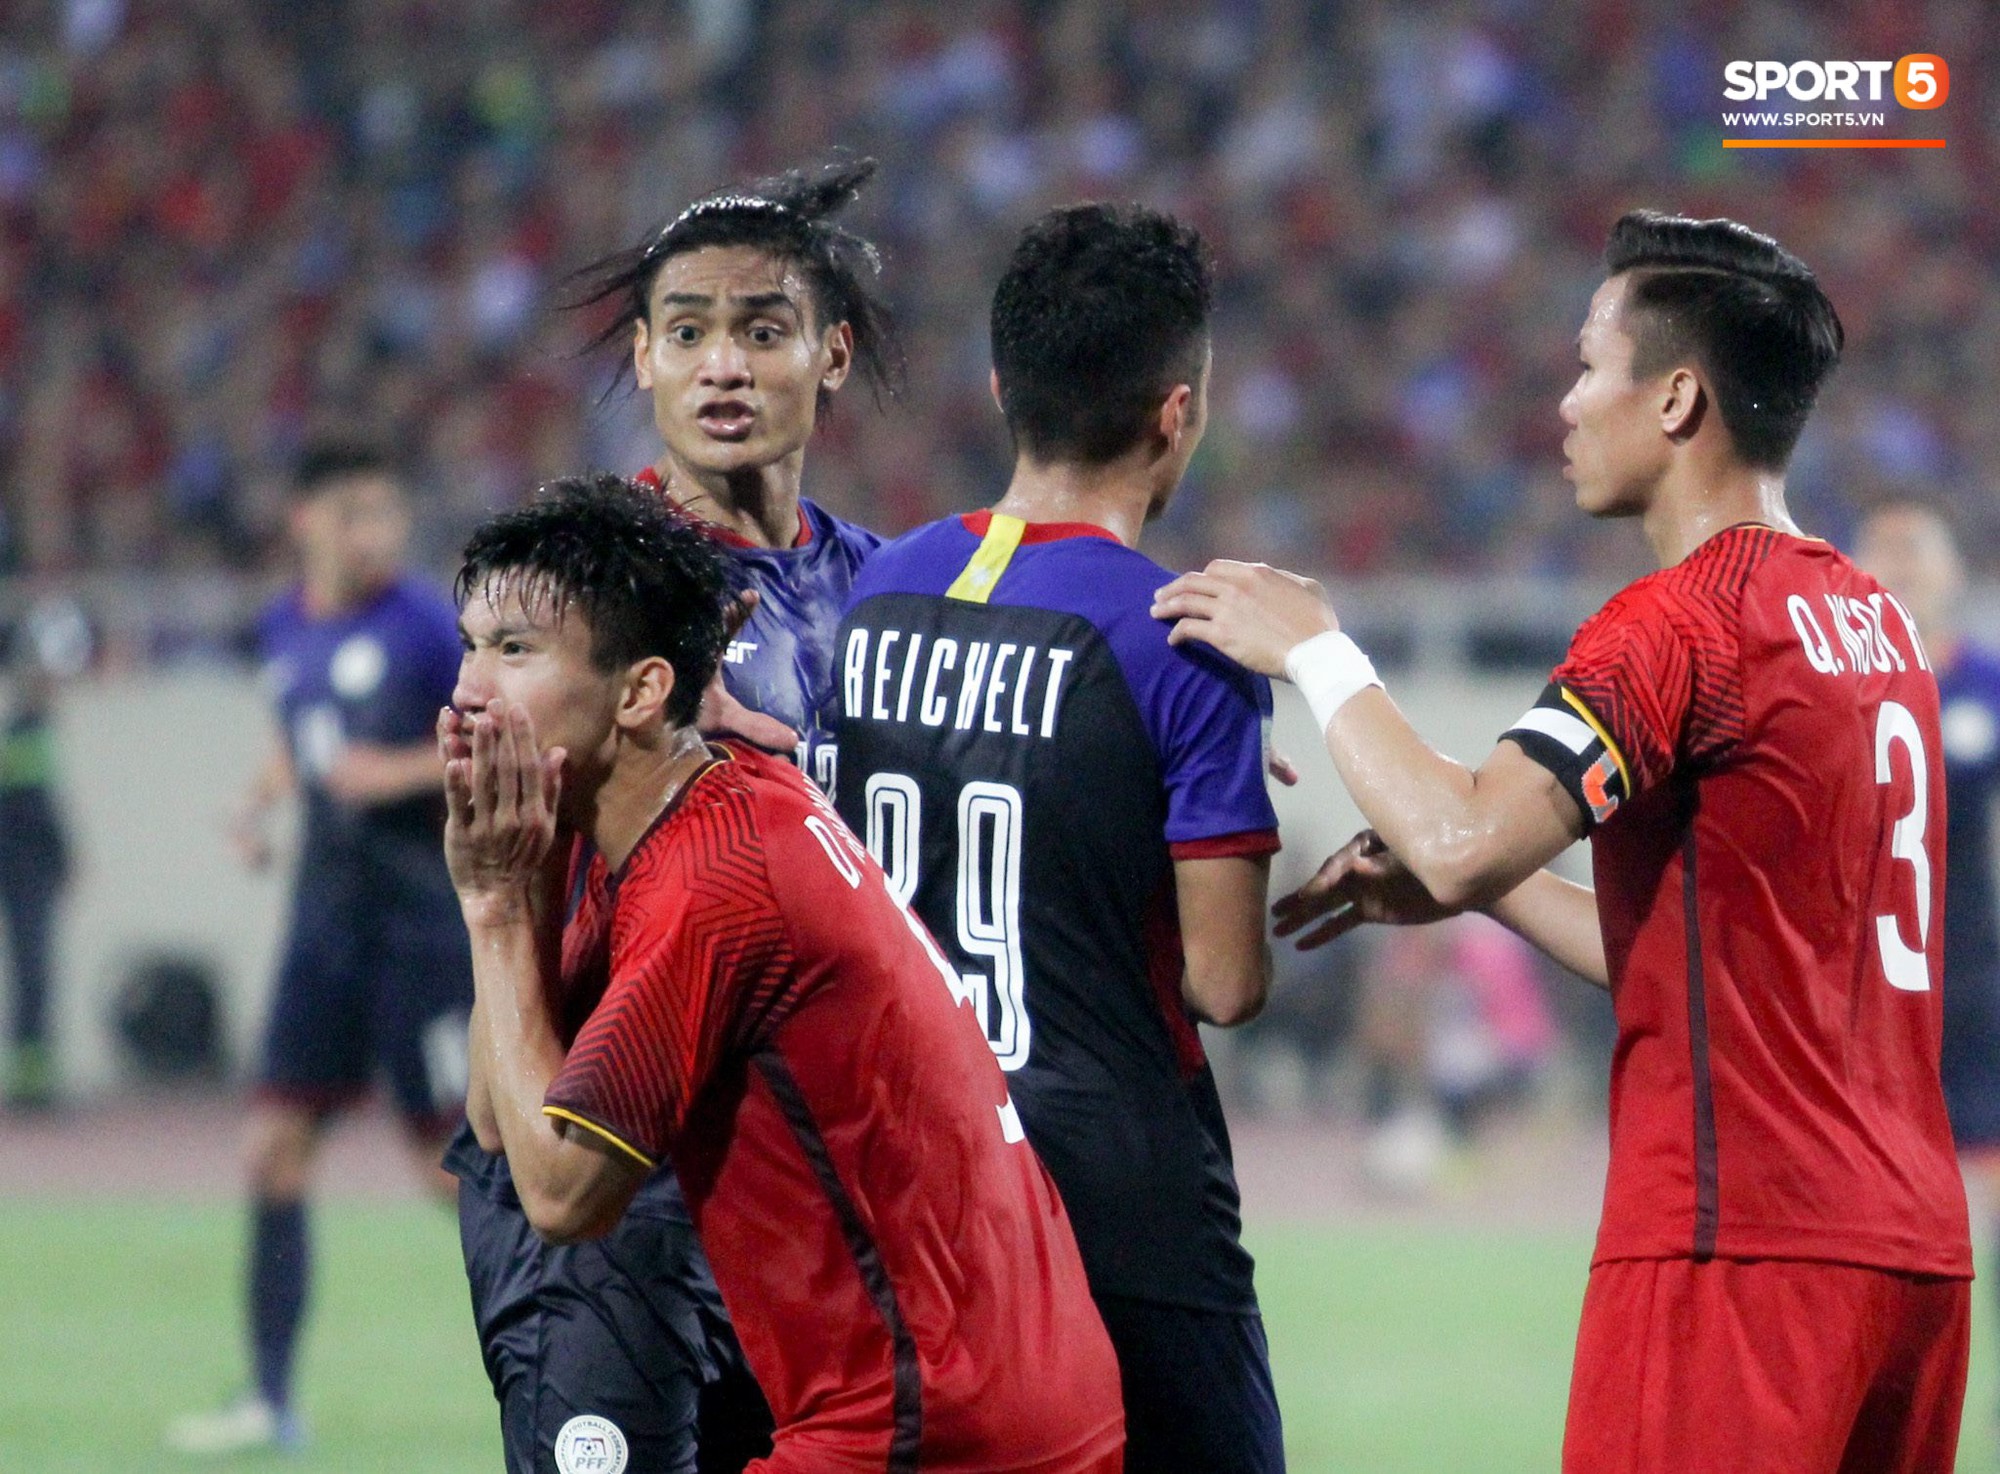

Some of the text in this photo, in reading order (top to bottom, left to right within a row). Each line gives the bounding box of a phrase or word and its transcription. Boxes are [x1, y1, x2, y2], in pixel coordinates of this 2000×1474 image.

[844, 628, 1074, 738] REICHELT
[1874, 700, 1931, 991] 3
[575, 1457, 608, 1469] PFF
